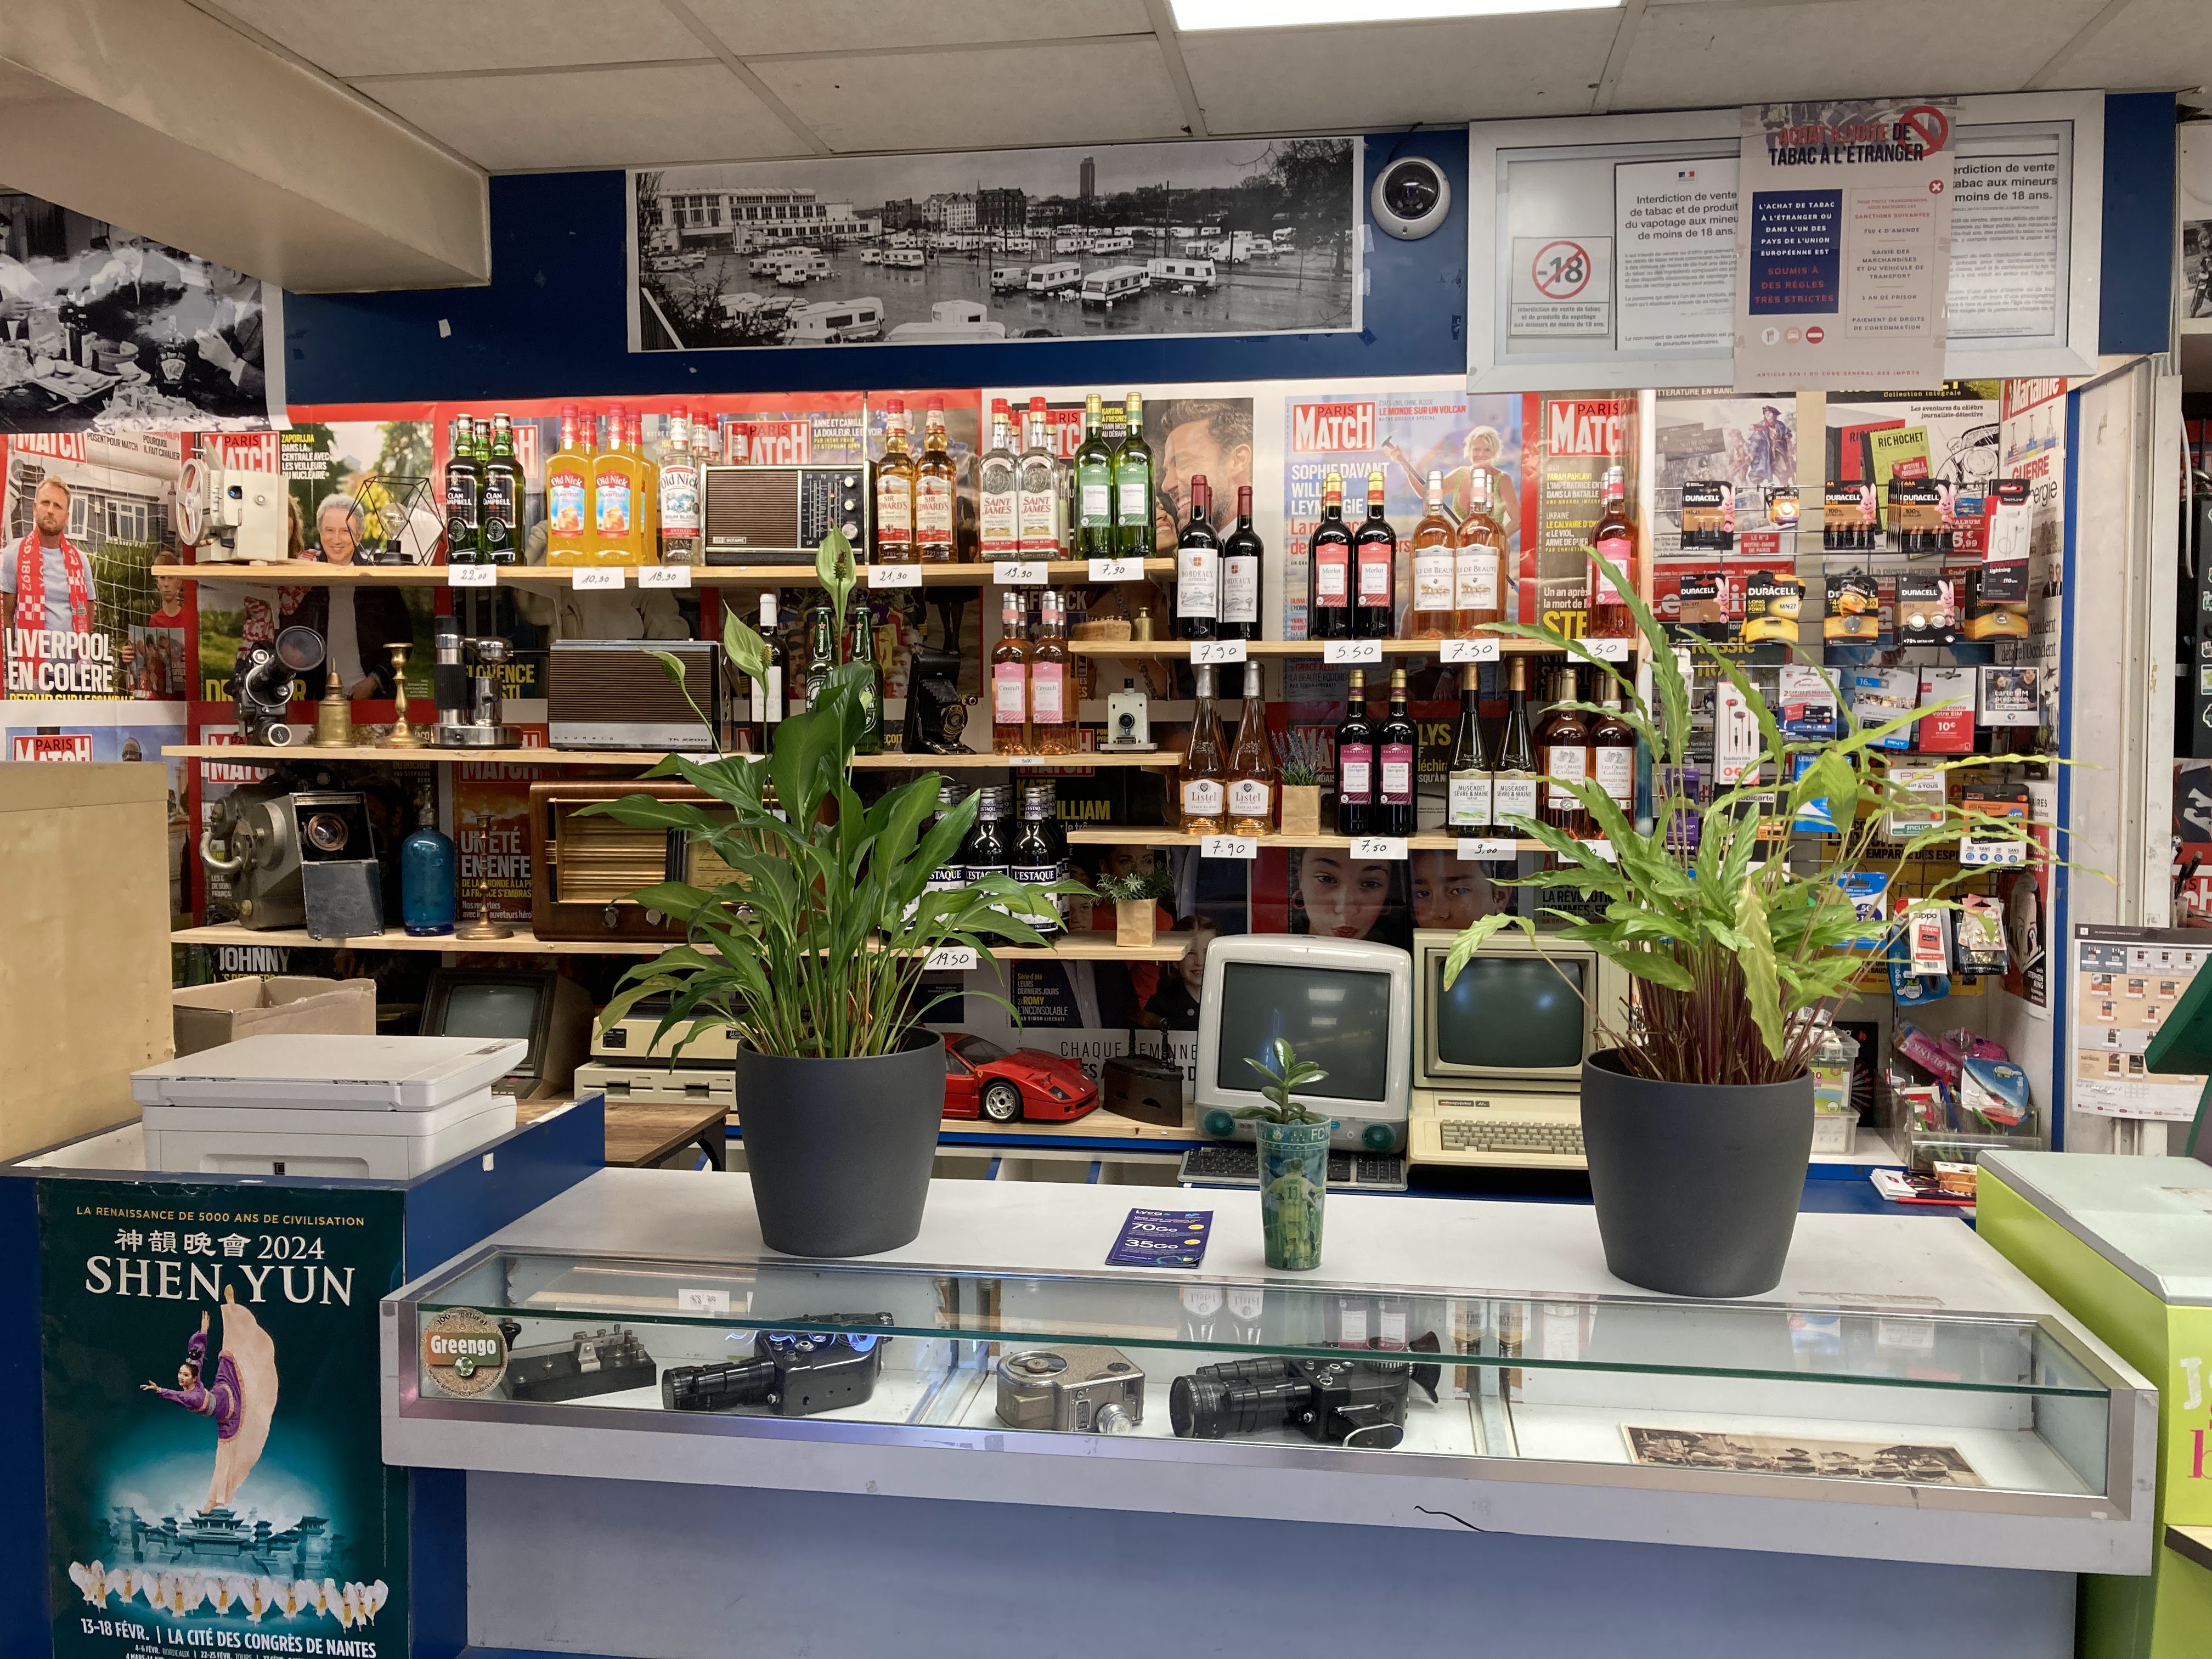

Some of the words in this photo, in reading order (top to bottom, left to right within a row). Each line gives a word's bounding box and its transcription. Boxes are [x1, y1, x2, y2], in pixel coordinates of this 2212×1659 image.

[1779, 126, 1827, 145] ACHAT
[1831, 123, 1889, 143] ILLICITE
[1893, 122, 1911, 140] DE
[1769, 146, 1816, 166] TABAC
[1820, 143, 1830, 163] À
[1834, 142, 1923, 163] L'ÉTRANGER
[2006, 163, 2019, 172] de
[2024, 163, 2055, 172] vente
[2011, 177, 2057, 186] mineurs
[1637, 194, 1691, 204] Interdiction
[1710, 191, 1737, 200] vente
[1955, 192, 1990, 201] moins
[1994, 191, 2007, 200] de
[2012, 191, 2024, 200] 18
[1641, 218, 1686, 229] vapotage
[1654, 230, 1682, 239] moins
[1701, 228, 1712, 236] 18
[1537, 257, 1583, 283] -18
[1812, 265, 1818, 273] À
[1785, 295, 1833, 303] STRICTES
[1317, 405, 1355, 416] PARIS
[1388, 407, 1413, 415] MONDE
[1414, 406, 1426, 414] SUR
[1440, 405, 1466, 414] VOLCAN
[1577, 403, 1618, 415] PARIS
[750, 425, 788, 436] PARIS
[1296, 405, 1372, 450] MATCH
[224, 435, 259, 447] PARIS
[281, 434, 314, 443] ZAPORIJJIA
[1878, 437, 1892, 448] RIC
[1893, 432, 1923, 445] HOCHET
[551, 476, 563, 486] Old
[565, 475, 583, 486] Nick
[597, 476, 610, 487] Old
[610, 475, 628, 487] Nick
[661, 475, 674, 489] Old
[677, 473, 699, 490] Nick
[983, 506, 1012, 515] JAMES
[1022, 505, 1051, 513] JAMES
[1102, 564, 1125, 575] 7,90
[461, 570, 487, 582] 22,00
[880, 572, 907, 582] 21,90
[1748, 587, 1796, 595] DURACELL
[6, 628, 114, 662] LIVERPOOL
[1201, 645, 1237, 661] 7.90
[8, 661, 33, 690] EN
[38, 661, 113, 692] COLÈRE
[36, 738, 72, 751] PARIS
[1192, 792, 1216, 802] Listel
[1235, 792, 1261, 802] Listel
[1212, 840, 1245, 856] 7.90
[1361, 839, 1387, 853] 7,50
[1474, 844, 1498, 854] 9,00
[1014, 871, 1054, 882] L'ESTAQUE
[219, 946, 291, 972] JOHNNY
[929, 952, 969, 966] 19.50
[1023, 996, 1044, 1005] ROMY
[1018, 1006, 1068, 1015] L'INCONSOLABLE
[1061, 1041, 1121, 1058] CHAQUE
[1287, 1186, 1299, 1199] 11
[77, 1206, 92, 1215] LA
[96, 1207, 174, 1220] RENAISSANCE
[178, 1211, 194, 1221] DE
[199, 1212, 230, 1222] 5000
[234, 1213, 259, 1223] ANS
[264, 1214, 278, 1223] DE
[283, 1215, 364, 1226] CIVILISATION
[1132, 1223, 1178, 1232] 70Go
[257, 1235, 325, 1260] 2024
[1125, 1239, 1178, 1249] 35Go
[85, 1255, 223, 1302] SHEN
[238, 1264, 356, 1306] YUN
[431, 1335, 496, 1356] Greengo
[81, 1618, 112, 1637] 13-18
[115, 1620, 149, 1641] FÉVR.
[167, 1628, 183, 1645] LA
[187, 1627, 213, 1646] CITÉ
[217, 1632, 239, 1648] DES
[244, 1630, 302, 1652] CONGRÈS
[306, 1637, 323, 1654] DE
[326, 1639, 377, 1658] NANTES
